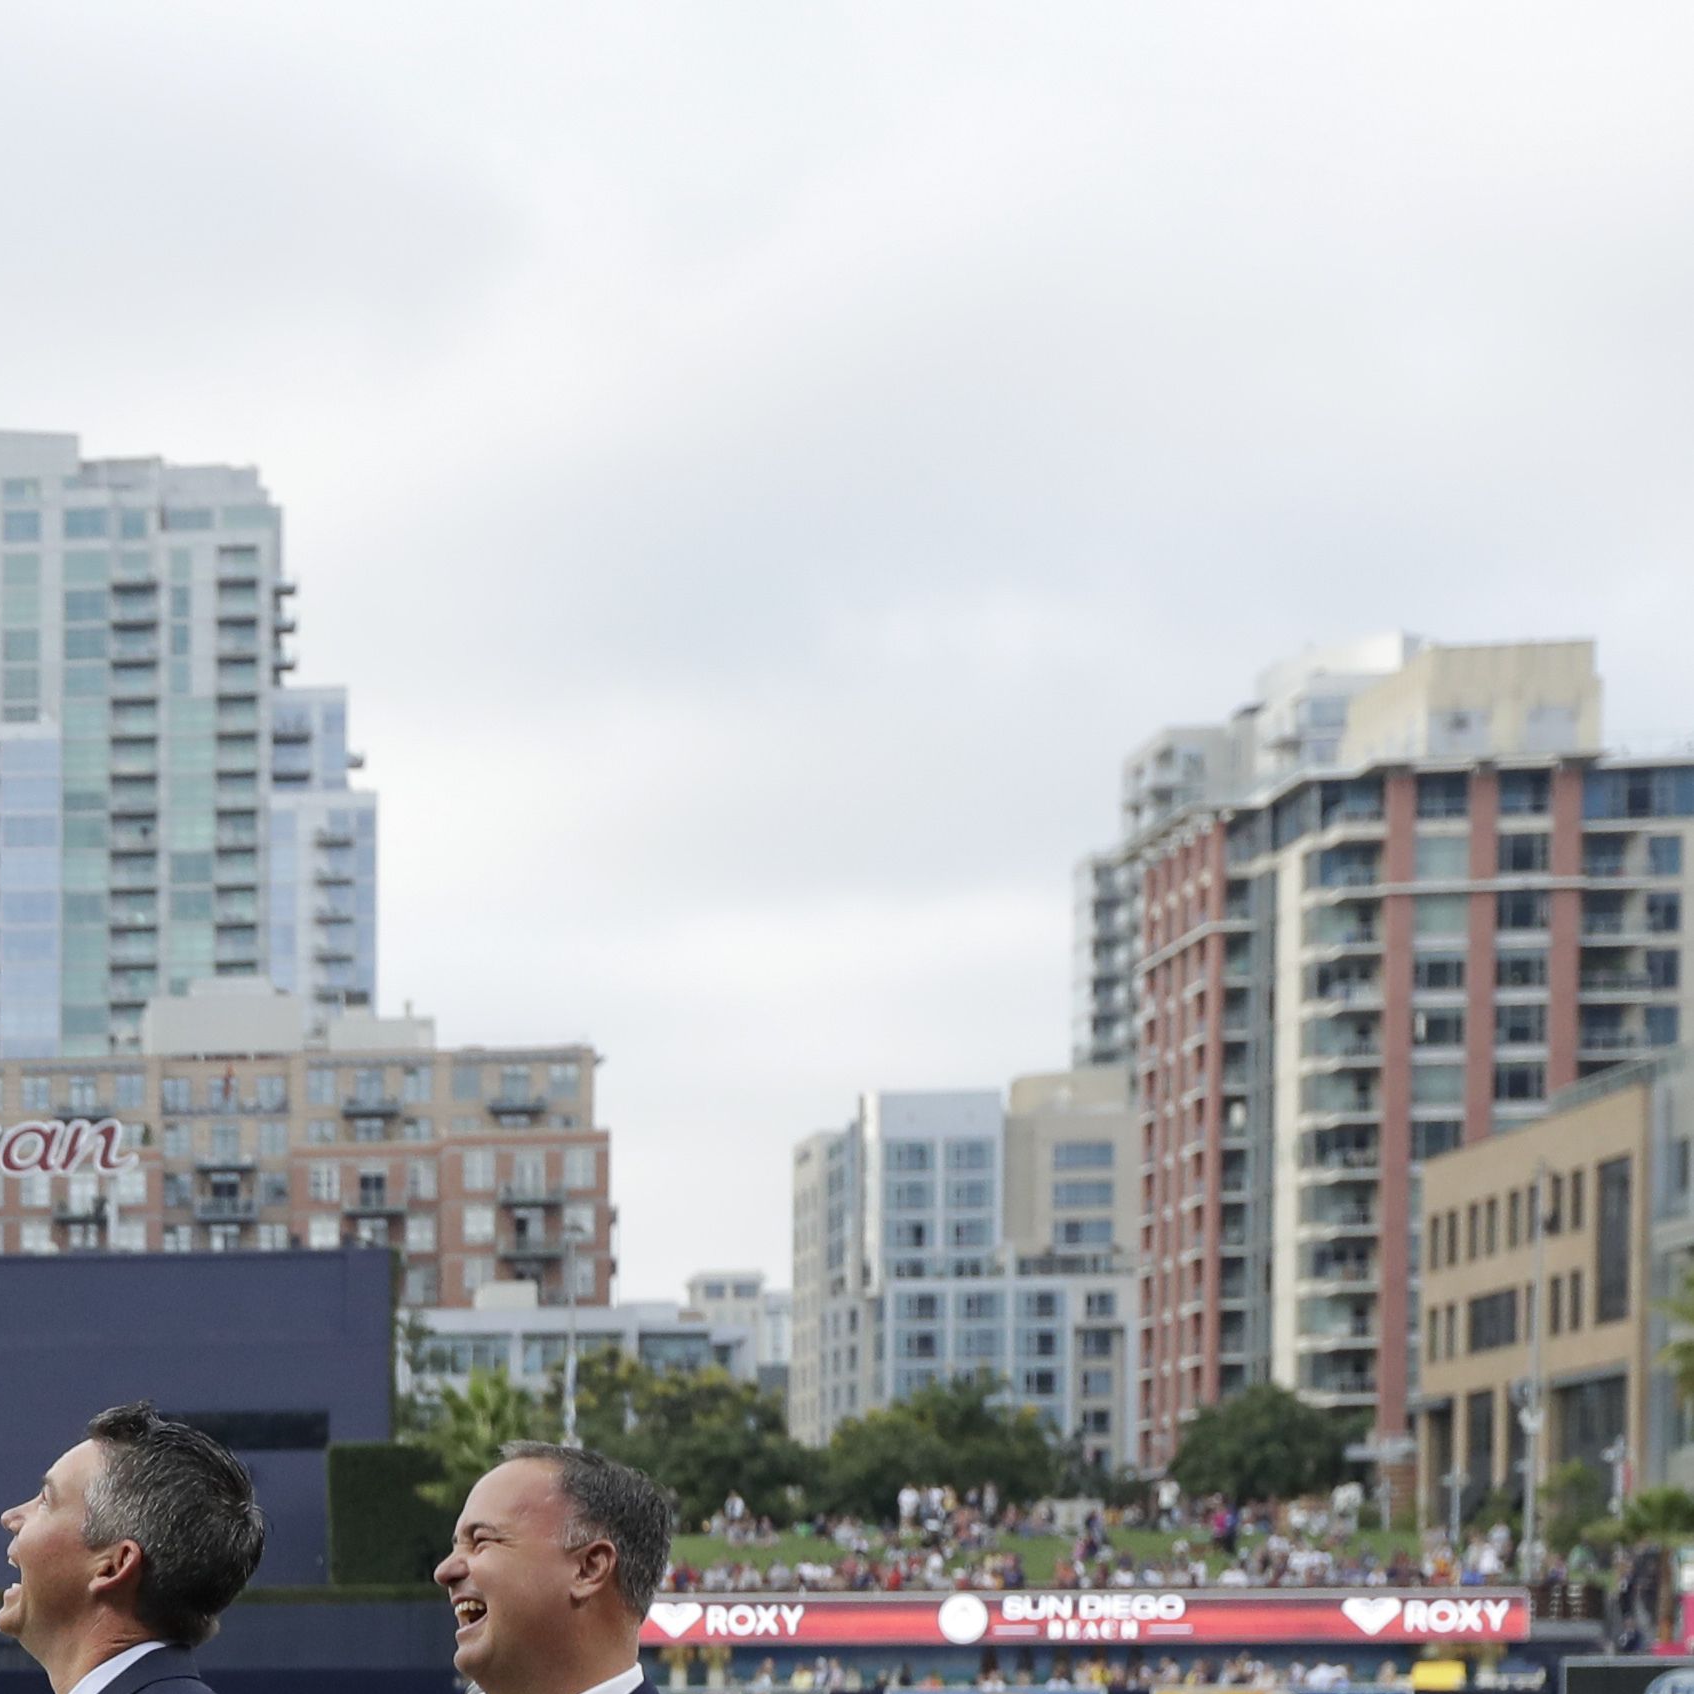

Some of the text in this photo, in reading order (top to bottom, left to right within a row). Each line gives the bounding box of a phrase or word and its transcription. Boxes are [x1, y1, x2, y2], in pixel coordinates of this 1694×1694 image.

[705, 1594, 1510, 1637] ROXY SUN DIEGO ROXY
[1046, 1619, 1140, 1640] BEACH
